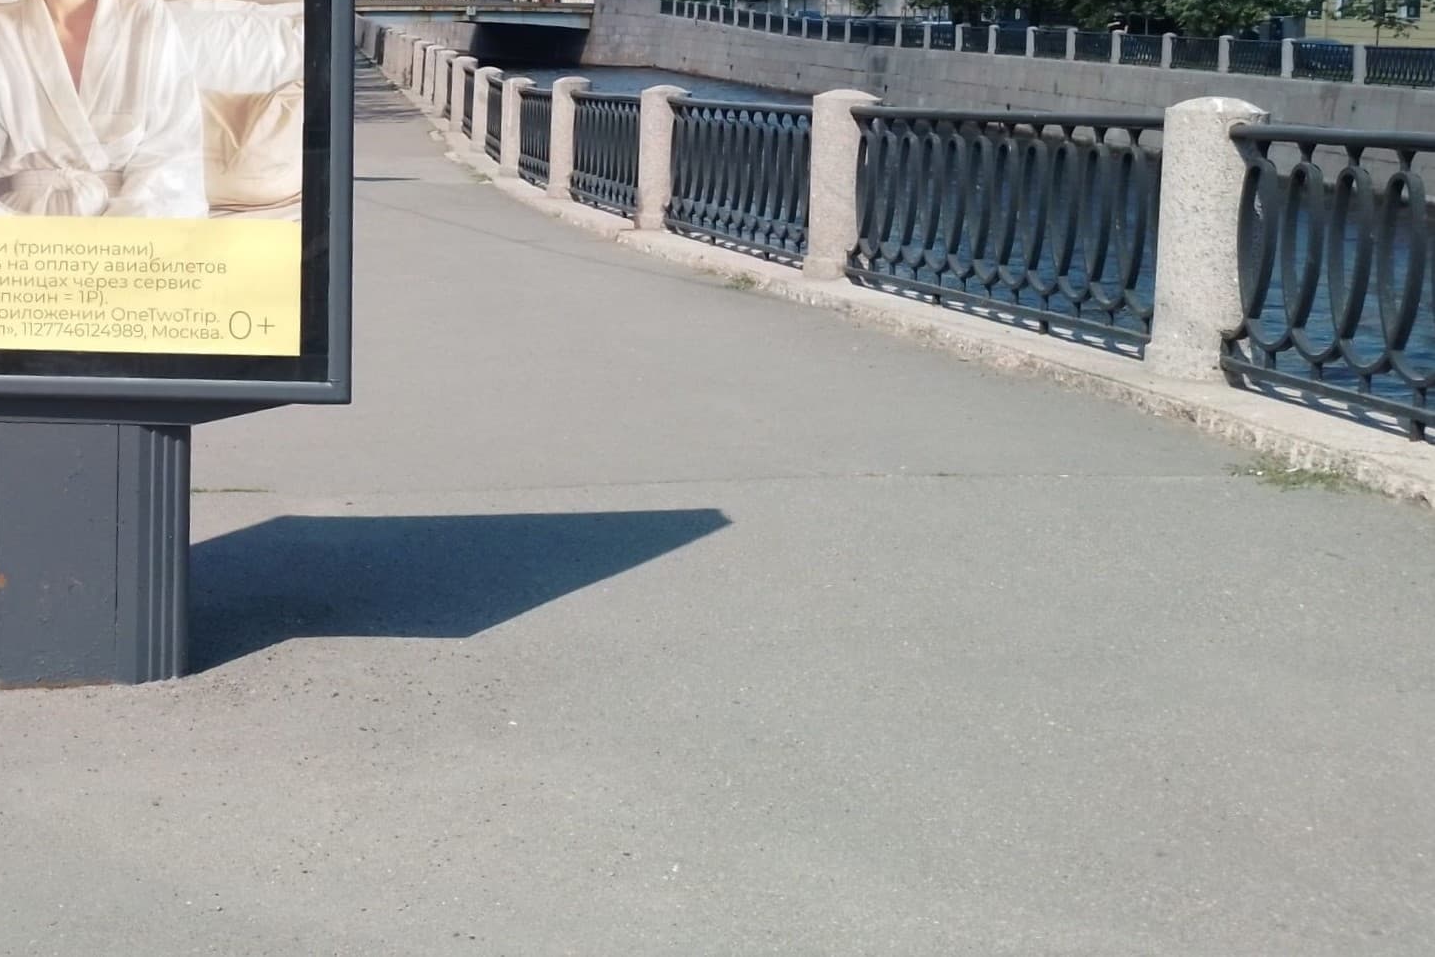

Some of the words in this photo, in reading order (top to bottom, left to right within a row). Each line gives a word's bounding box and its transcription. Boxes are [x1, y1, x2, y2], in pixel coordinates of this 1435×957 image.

[13, 240, 154, 260] (трипкоинами)
[7, 258, 29, 271] на
[34, 259, 99, 275] оплату
[104, 257, 227, 274] авиабилетов
[73, 276, 128, 291] через
[133, 277, 202, 291] сервис
[111, 307, 221, 324] OneTwoTrip.
[152, 325, 224, 340] Москва.
